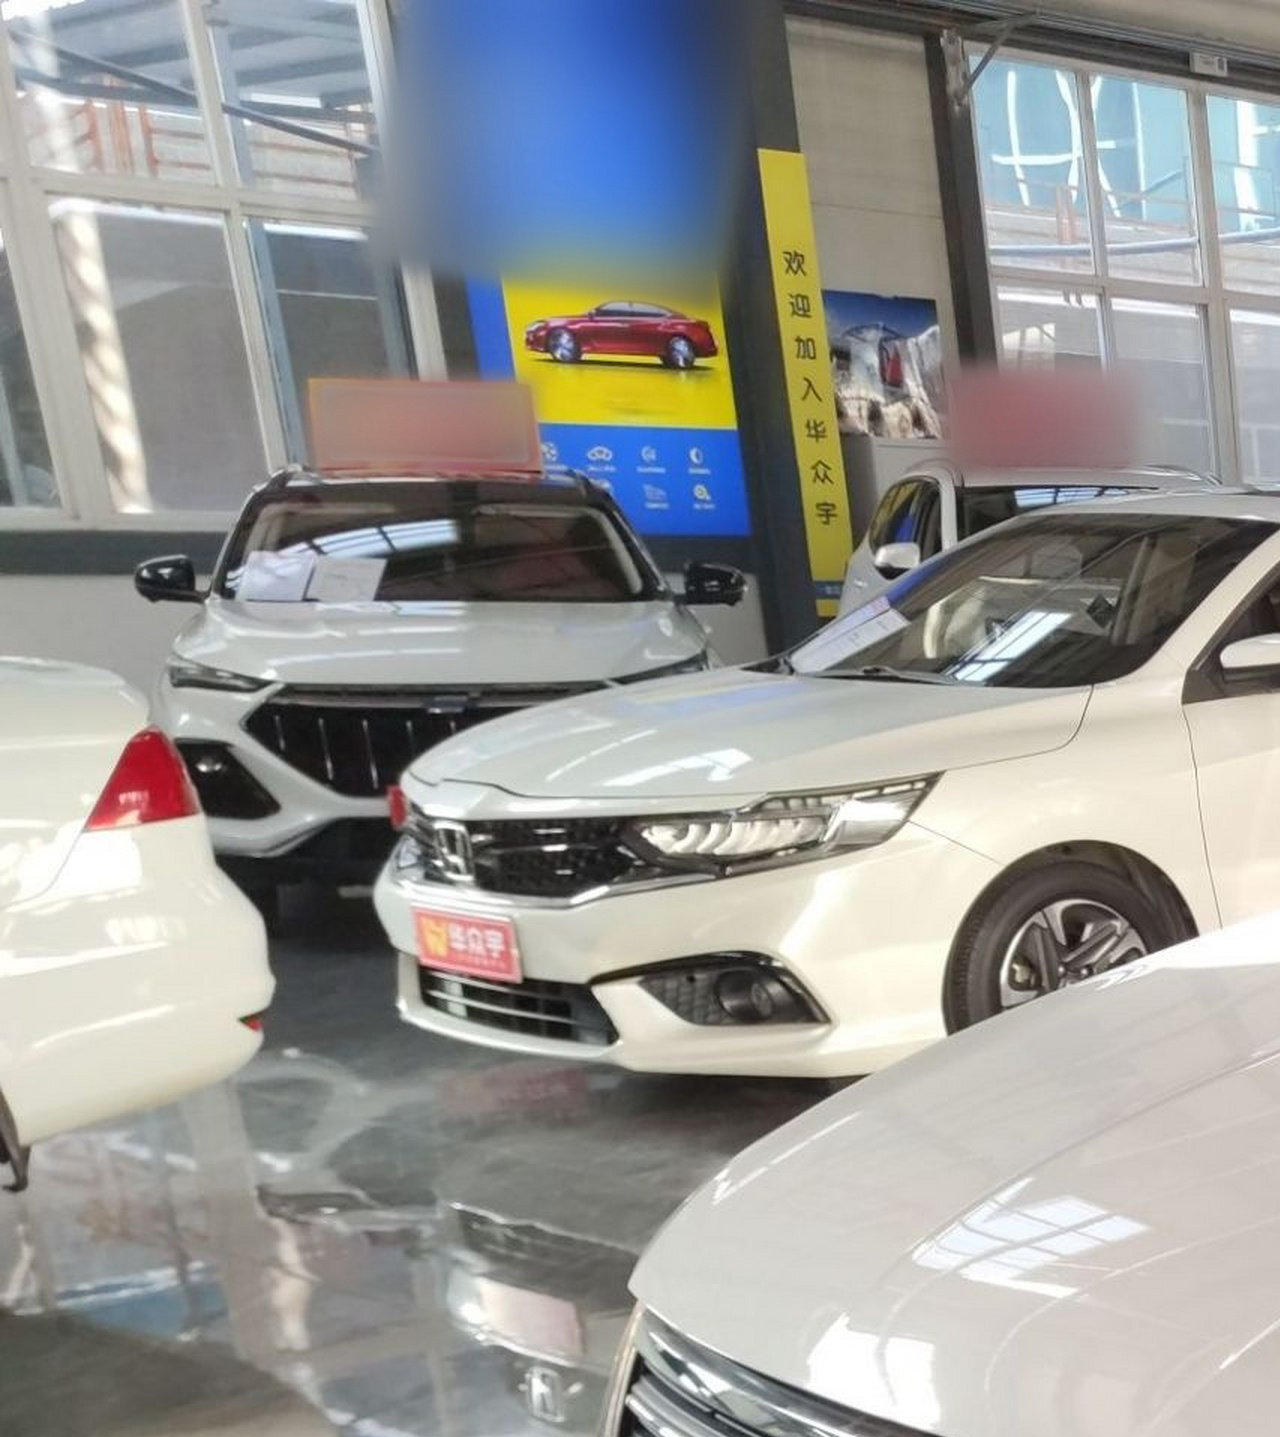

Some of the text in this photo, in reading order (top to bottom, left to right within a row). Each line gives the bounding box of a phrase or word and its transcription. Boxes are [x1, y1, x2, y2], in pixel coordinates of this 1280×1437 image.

[783, 251, 837, 525] 欢迎加入华众宇
